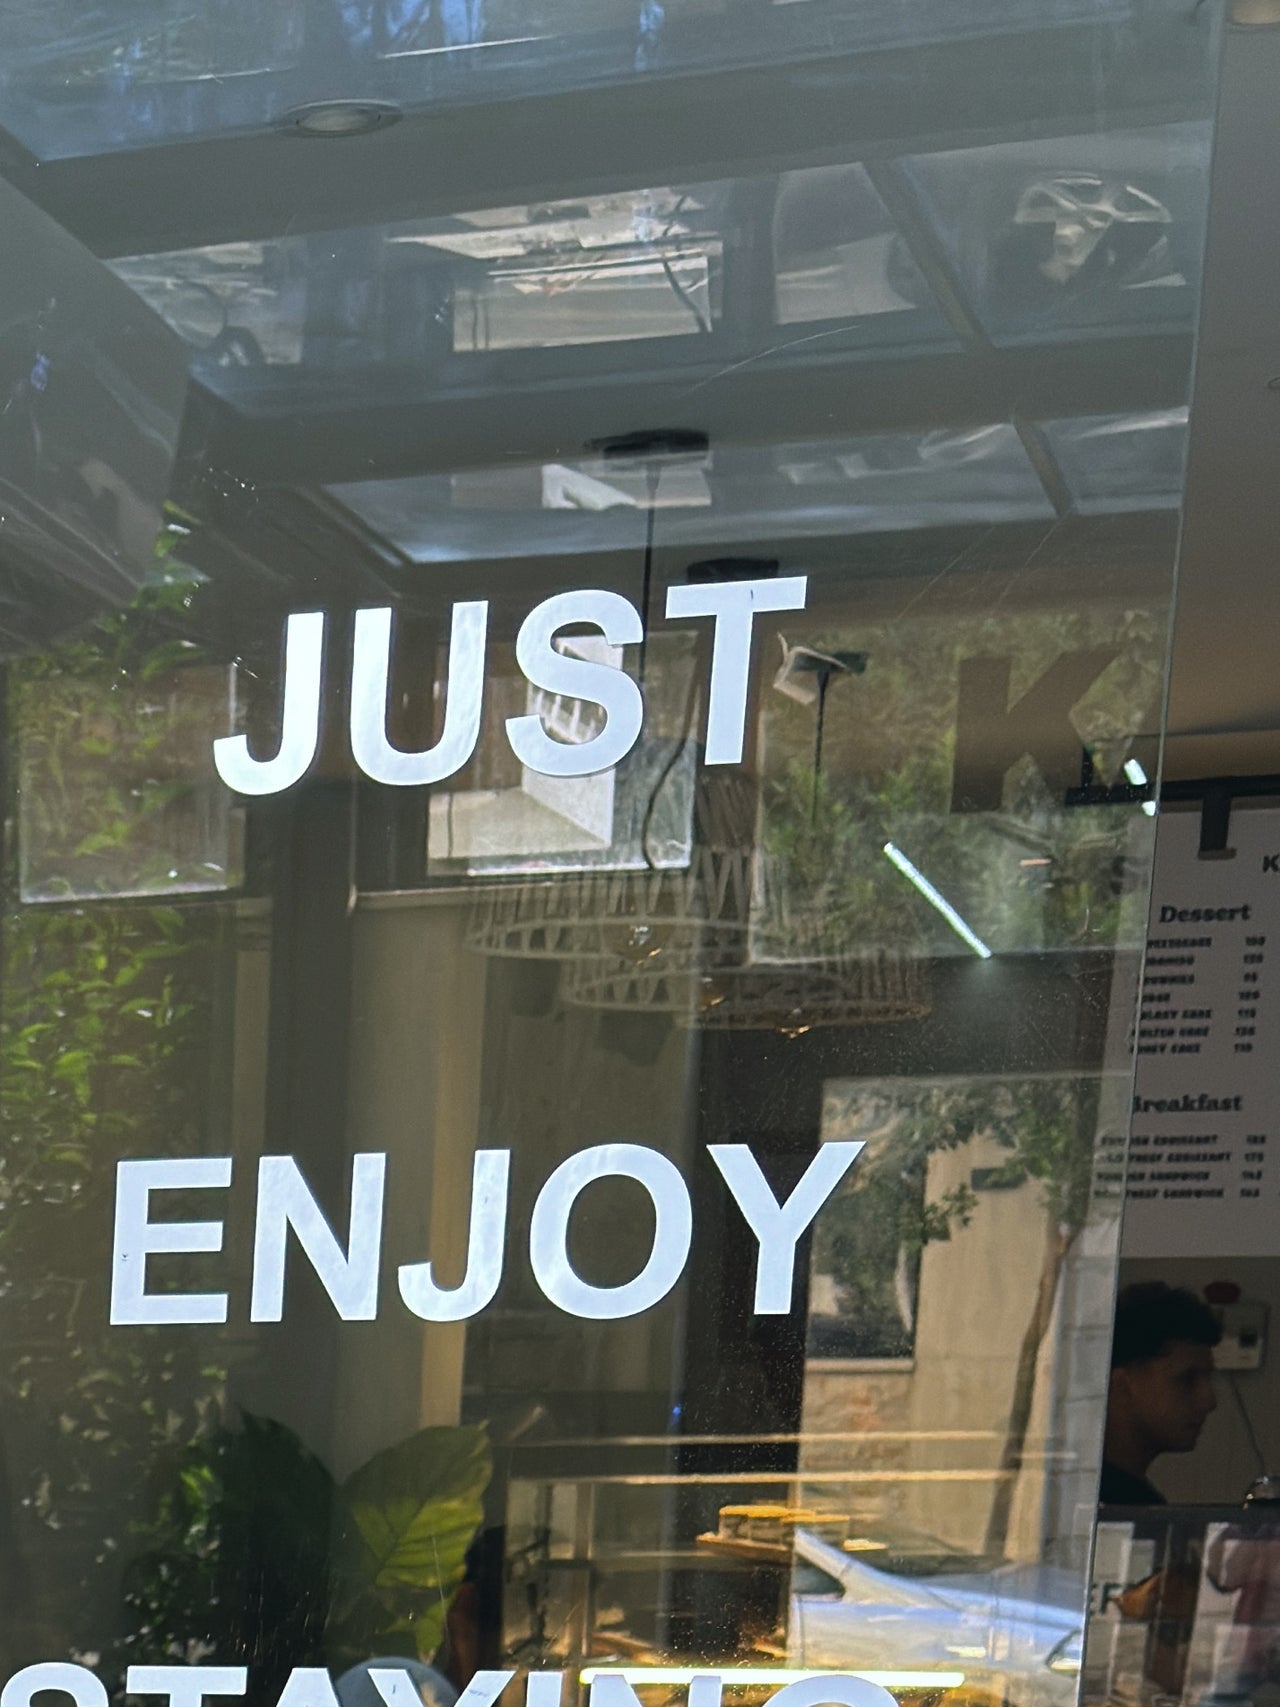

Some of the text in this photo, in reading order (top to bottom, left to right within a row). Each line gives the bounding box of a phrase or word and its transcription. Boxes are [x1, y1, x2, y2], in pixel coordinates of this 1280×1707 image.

[213, 574, 808, 796] JUST
[1159, 904, 1252, 924] Dessert
[109, 1140, 867, 1326] ENJOY
